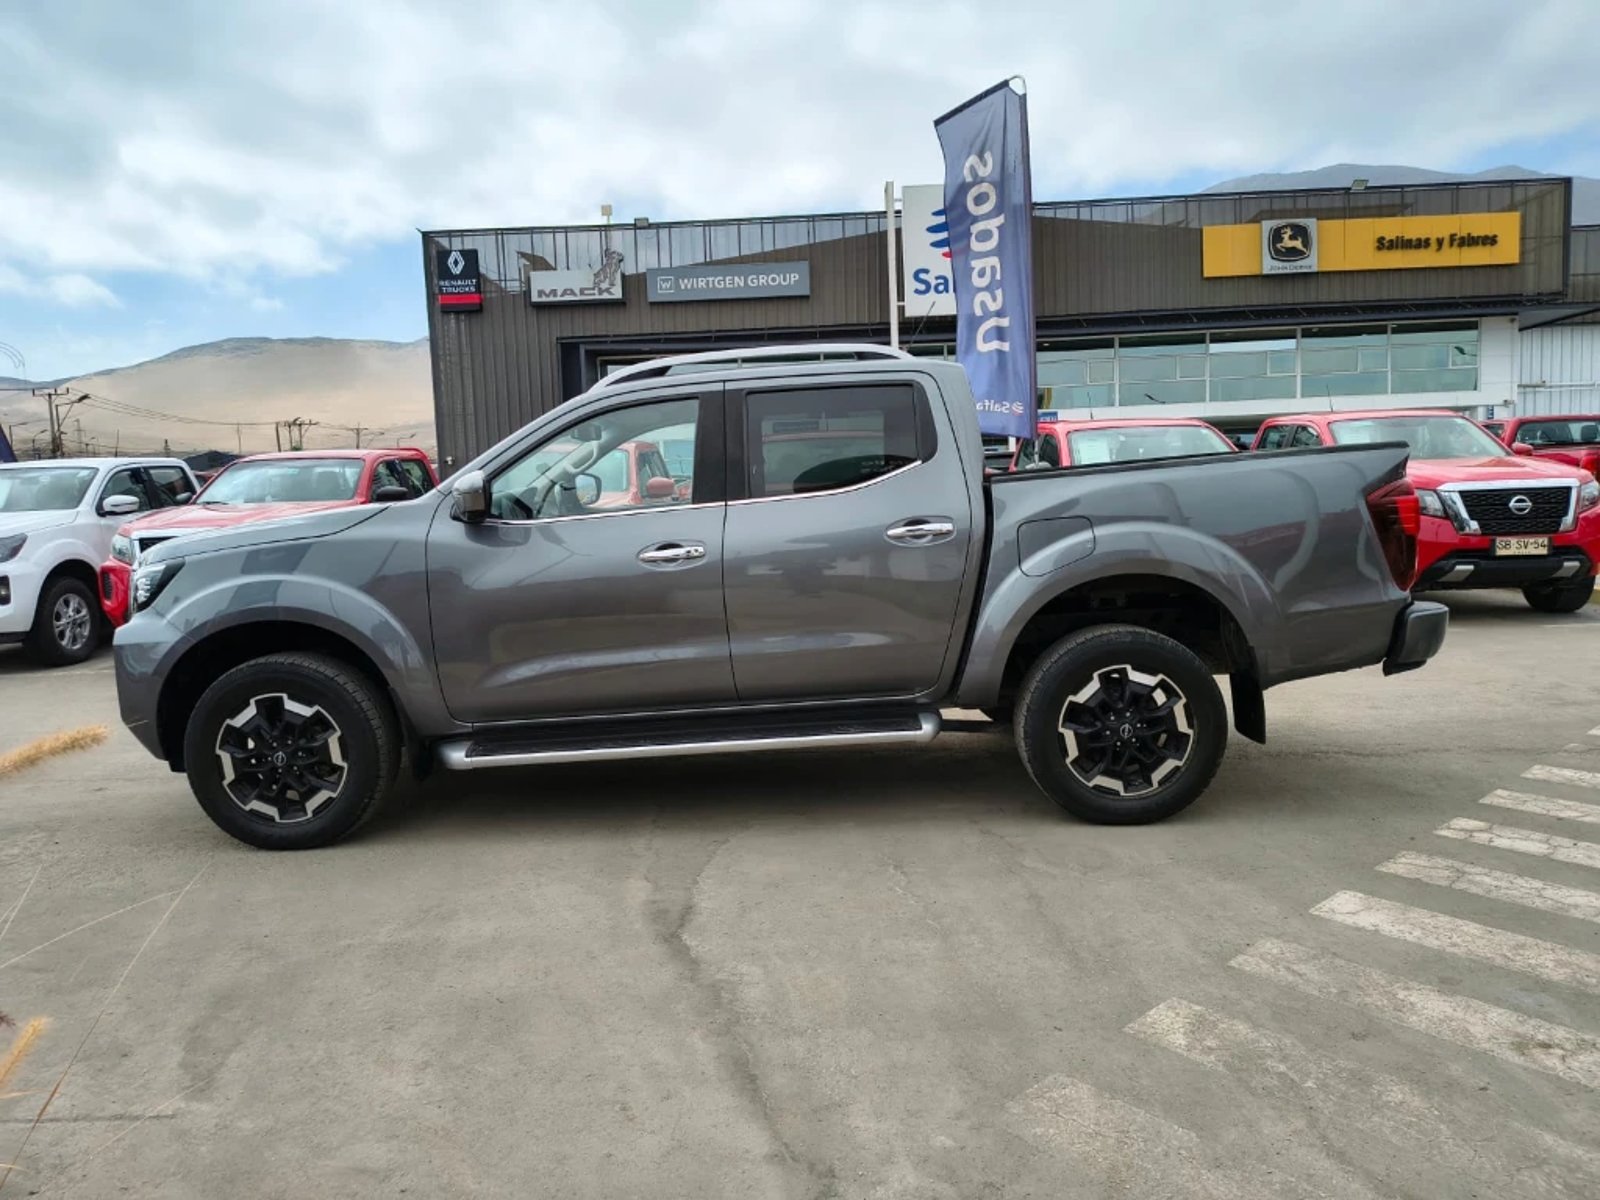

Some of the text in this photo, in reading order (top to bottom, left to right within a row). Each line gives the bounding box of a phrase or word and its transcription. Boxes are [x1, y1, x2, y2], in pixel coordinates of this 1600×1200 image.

[1376, 232, 1498, 252] Salinas y Fabres
[679, 276, 745, 290] WIRTGEN
[747, 273, 799, 287] GROUP
[537, 287, 616, 298] MACK
